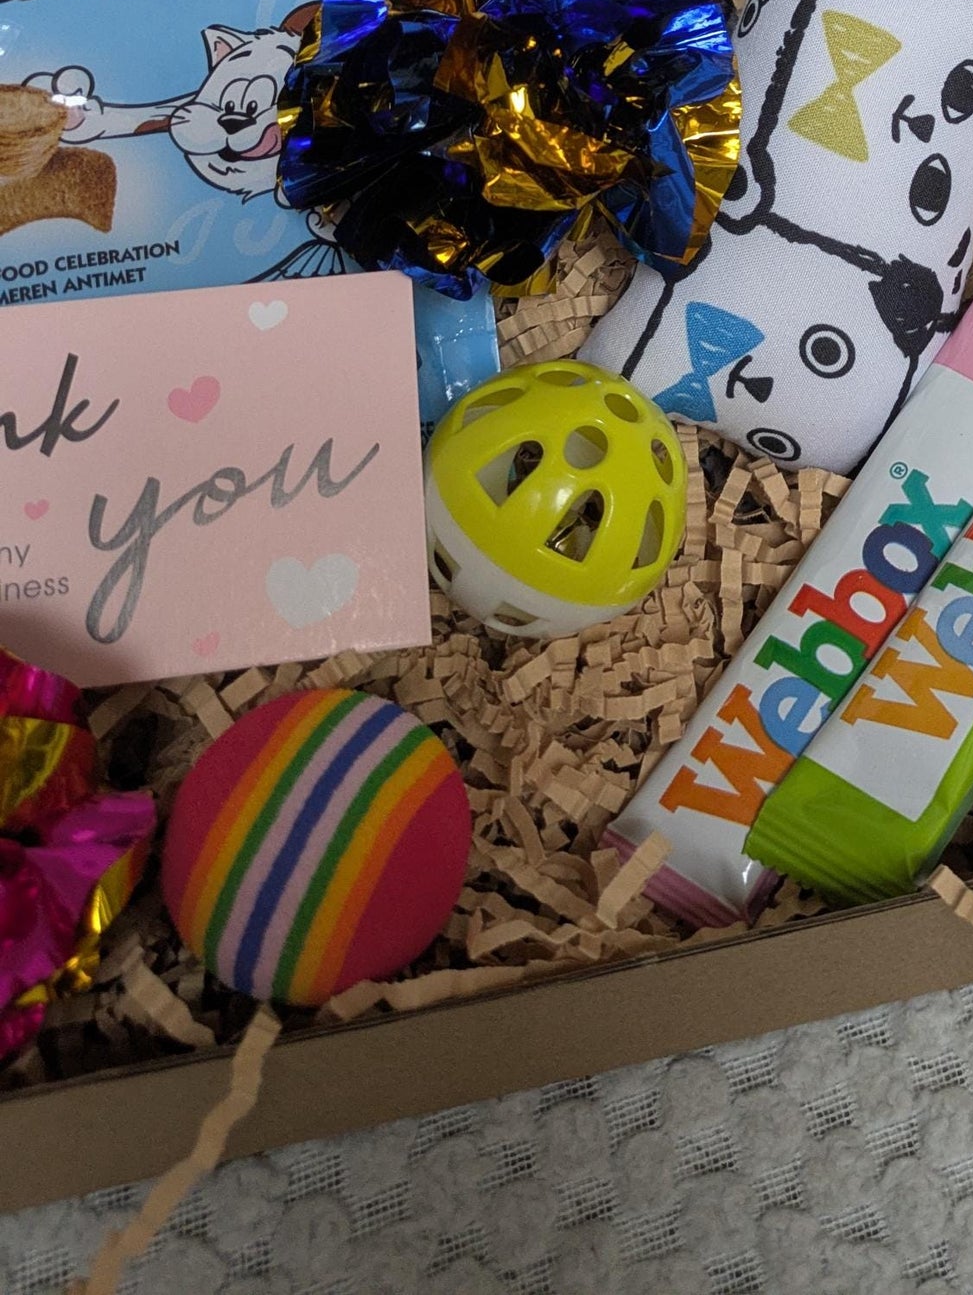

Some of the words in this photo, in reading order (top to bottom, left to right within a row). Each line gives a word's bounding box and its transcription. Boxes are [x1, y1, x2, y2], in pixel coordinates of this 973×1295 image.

[0, 259, 48, 282] OOD
[54, 239, 180, 272] CELEBRATION
[62, 267, 147, 294] ANTIMET
[85, 437, 381, 644] you
